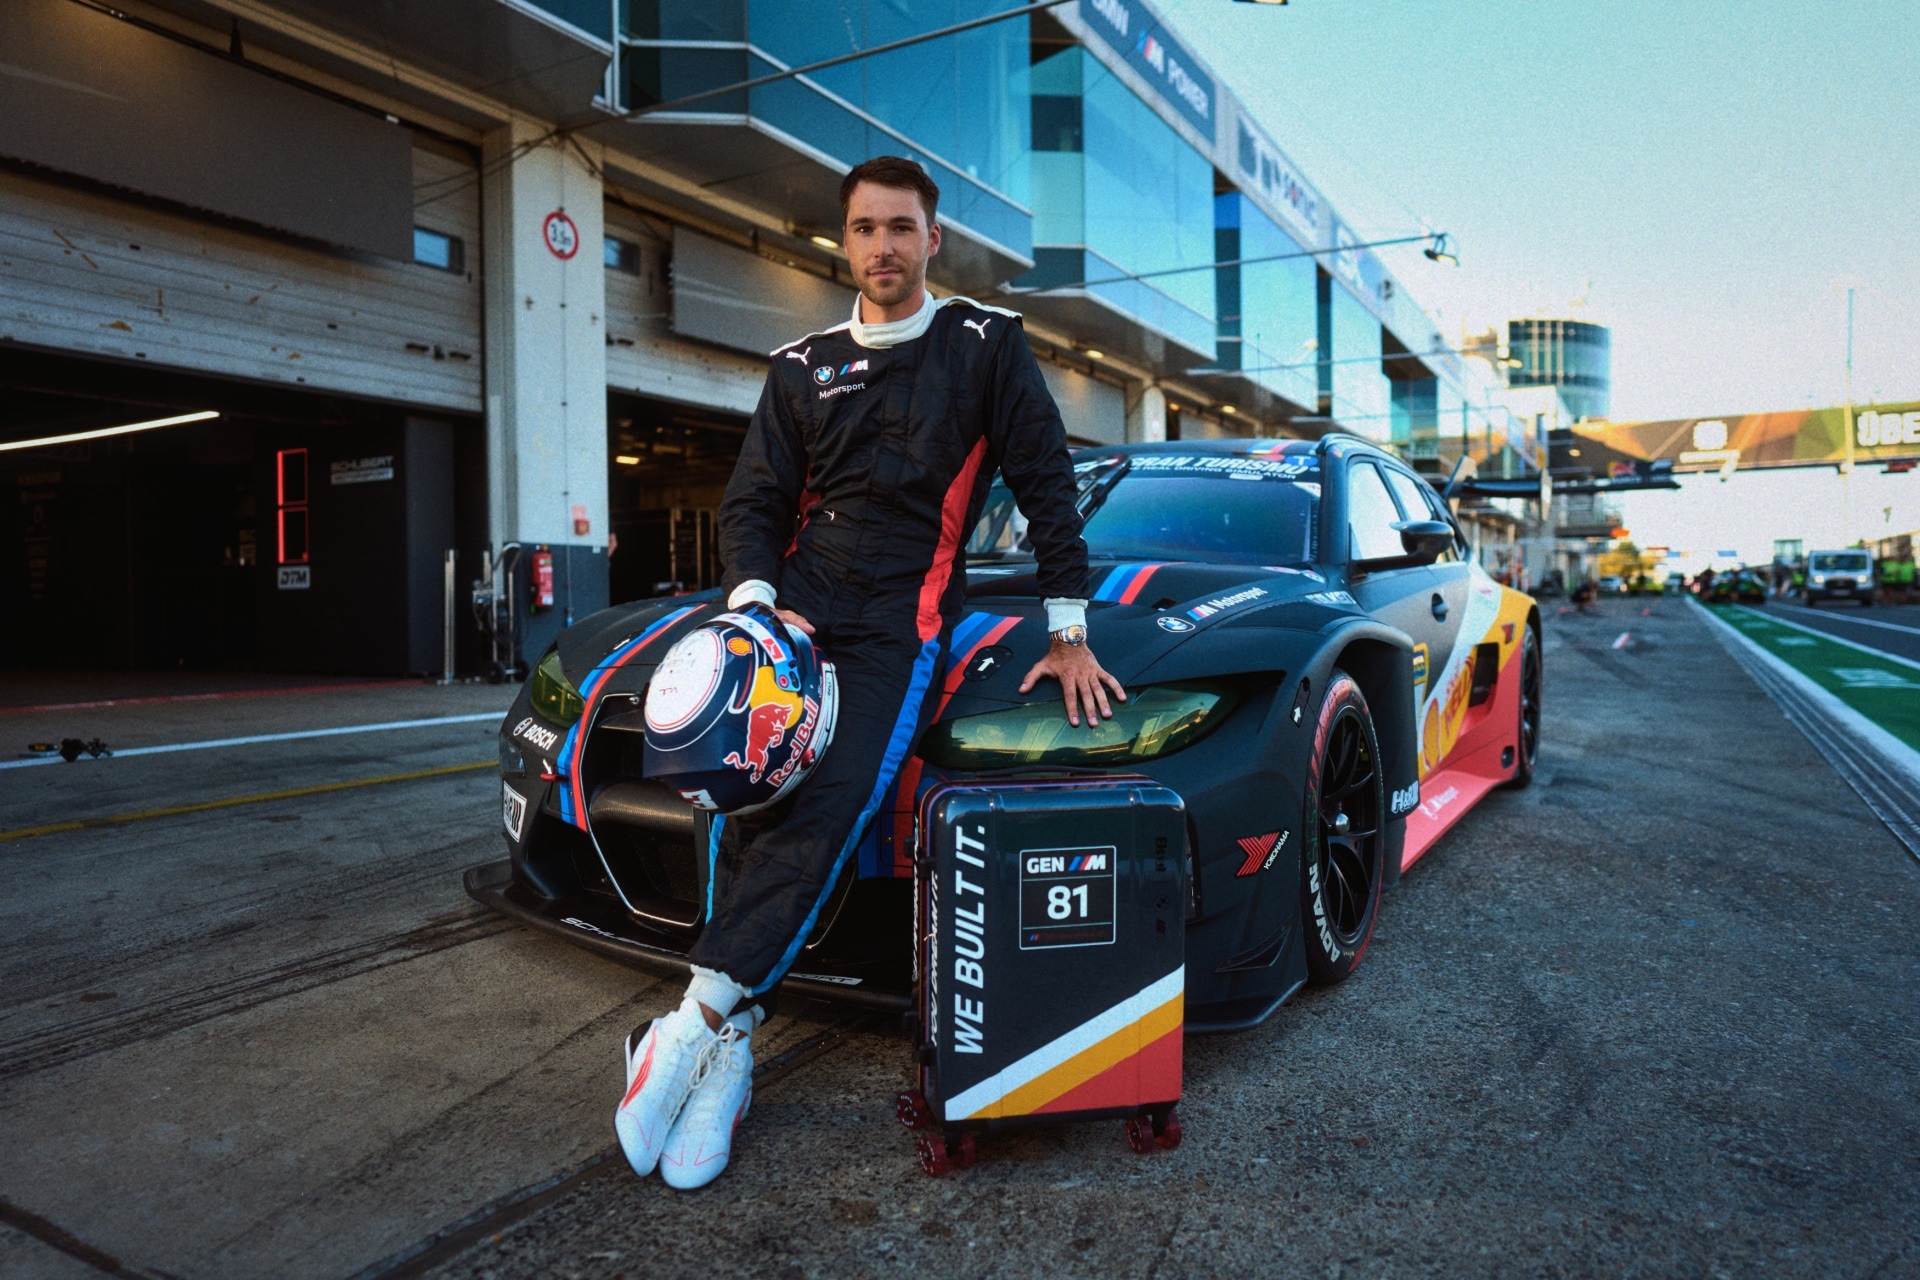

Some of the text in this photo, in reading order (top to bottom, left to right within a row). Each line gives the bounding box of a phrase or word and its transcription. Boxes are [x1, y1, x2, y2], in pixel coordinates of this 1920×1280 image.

[819, 382, 866, 400] Motorsport
[1193, 457, 1309, 475] TURISMO
[1225, 468, 1296, 480] SIMULATOR
[280, 569, 308, 586] DTM
[1213, 587, 1268, 610] Motorsport
[523, 724, 558, 751] BOSCH
[766, 694, 819, 787] Red Bull
[1263, 830, 1290, 870] YOKOHAMA
[1026, 856, 1065, 874] GEN
[1047, 883, 1088, 920] 81
[1309, 862, 1341, 963] ADVAN
[954, 825, 986, 1055] WE BUILT IT.
[930, 991, 938, 1048] YOU
